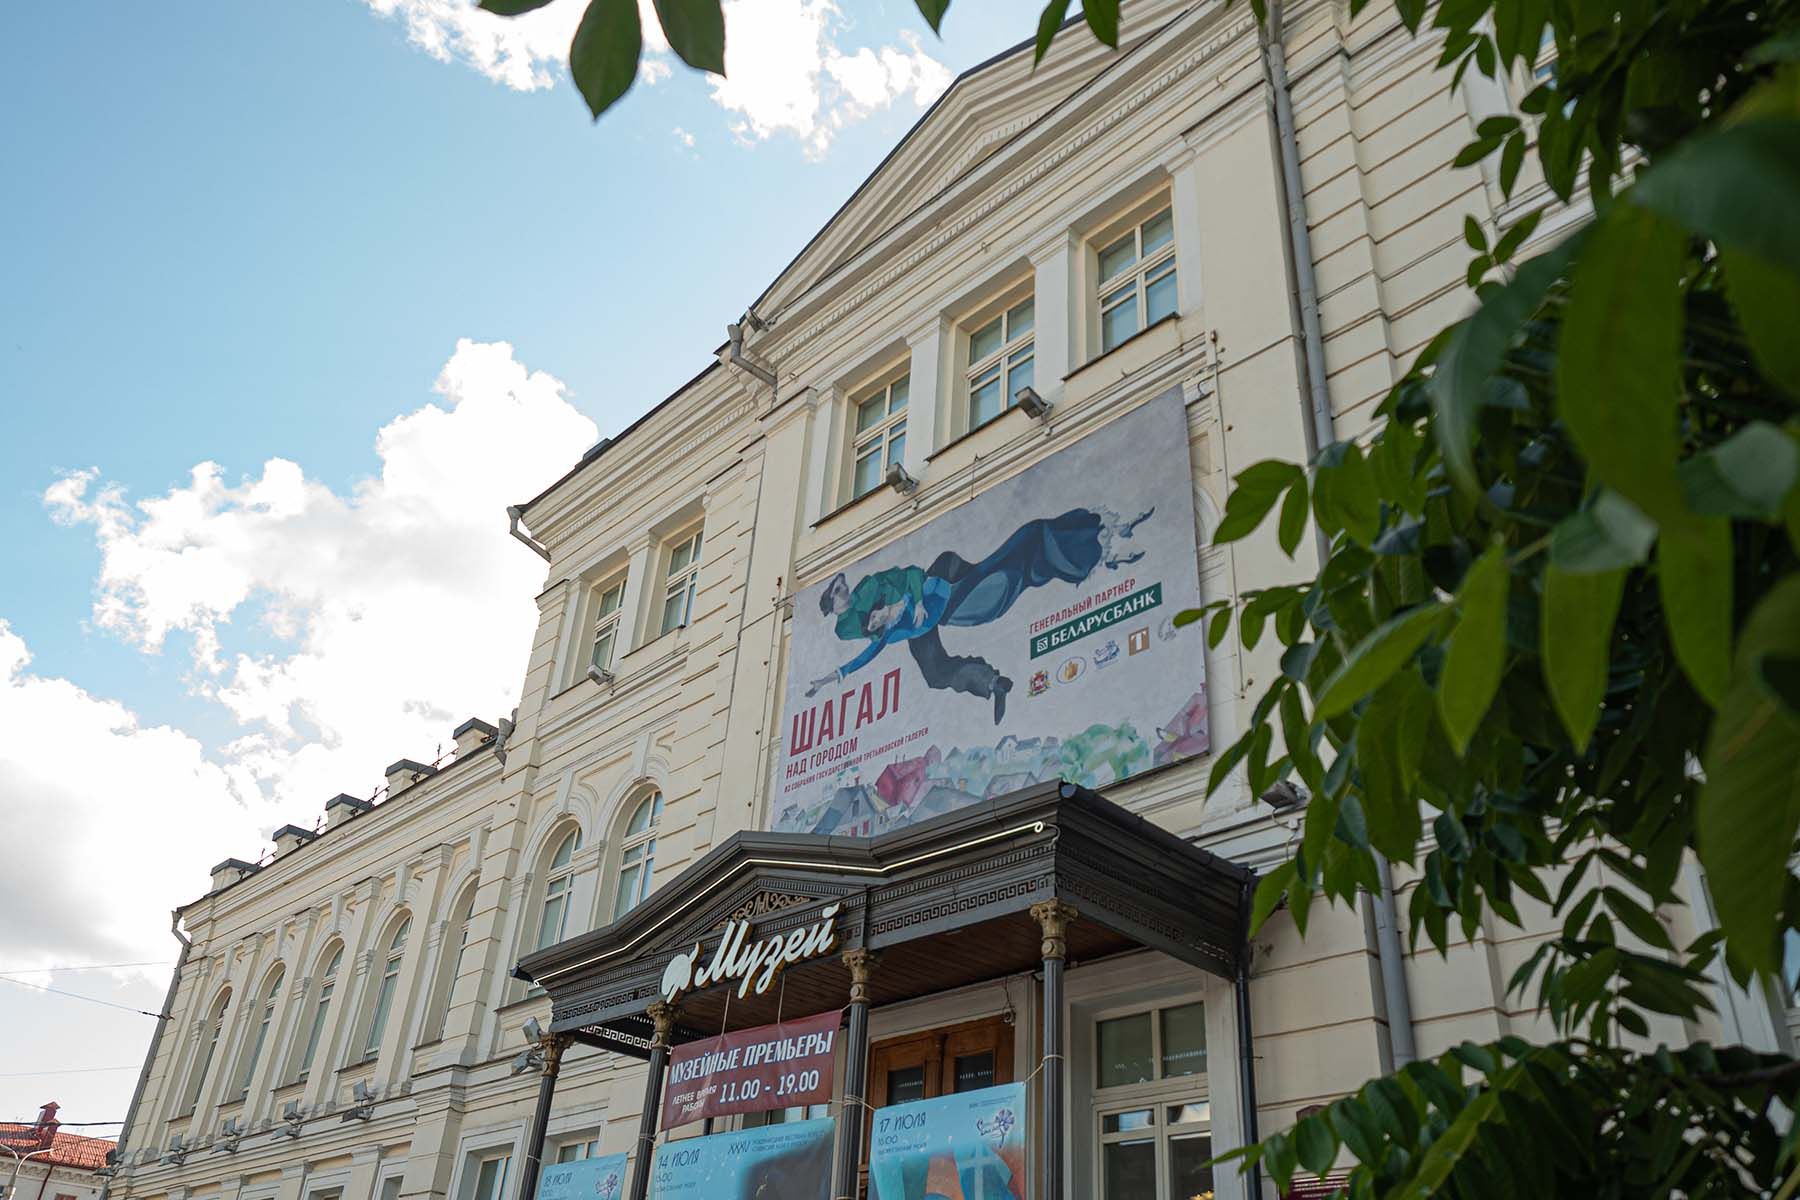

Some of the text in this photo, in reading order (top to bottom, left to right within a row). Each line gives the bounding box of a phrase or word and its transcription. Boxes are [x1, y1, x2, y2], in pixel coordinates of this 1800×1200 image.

[1030, 596, 1093, 634] ГЕНЕРАЛЬНЫЙ
[1051, 590, 1156, 647] БЕЛАРУСБАНК
[790, 667, 902, 757] ШАГАЛ
[904, 727, 929, 743] ГАЛЕРЕИ
[786, 736, 859, 779] НАД ГОРОДОМ
[694, 903, 841, 999] Музей
[670, 1031, 834, 1085] МУЗЕЙНЫЕ ПРЕМЬЕРЫ
[672, 1090, 695, 1105] ЛЕТНЕЕ
[719, 1079, 761, 1104] 11.00
[776, 1070, 820, 1096] 19.00
[879, 1118, 891, 1134] 17
